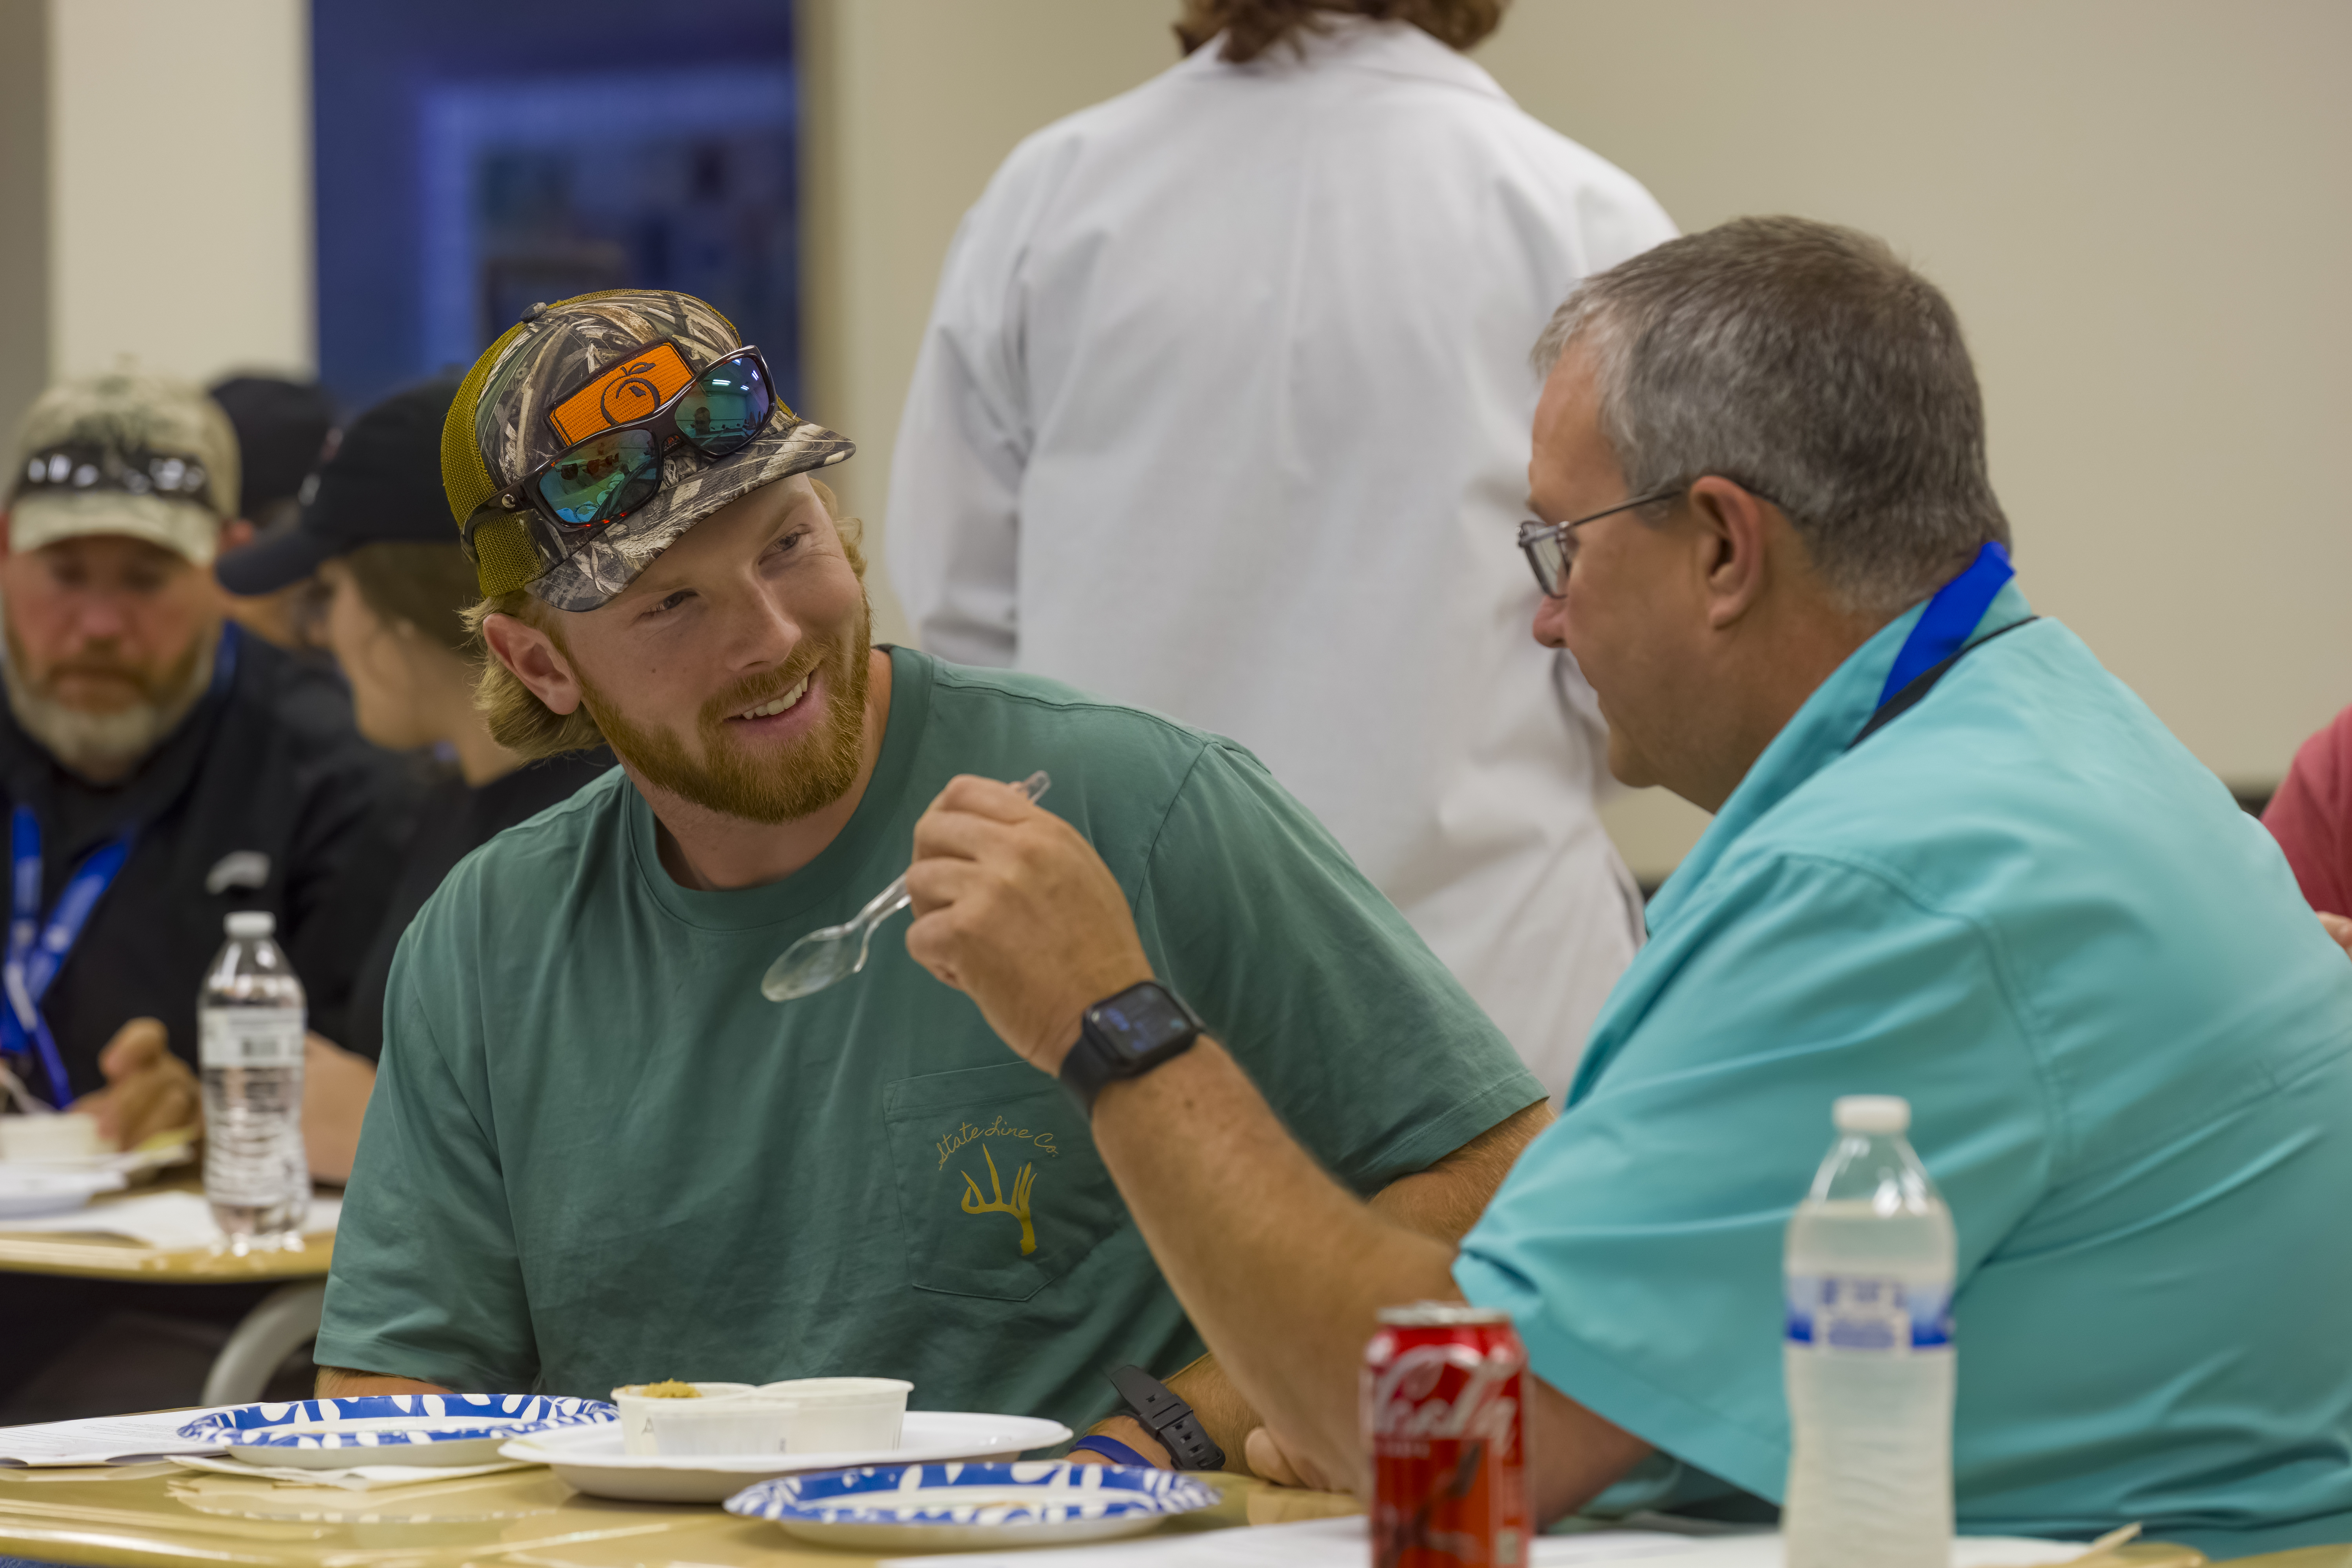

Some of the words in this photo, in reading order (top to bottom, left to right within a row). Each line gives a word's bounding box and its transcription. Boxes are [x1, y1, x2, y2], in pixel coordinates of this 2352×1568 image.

[937, 1122, 984, 1170] State
[985, 1116, 1034, 1138] Line
[1034, 1133, 1058, 1157] Co.
